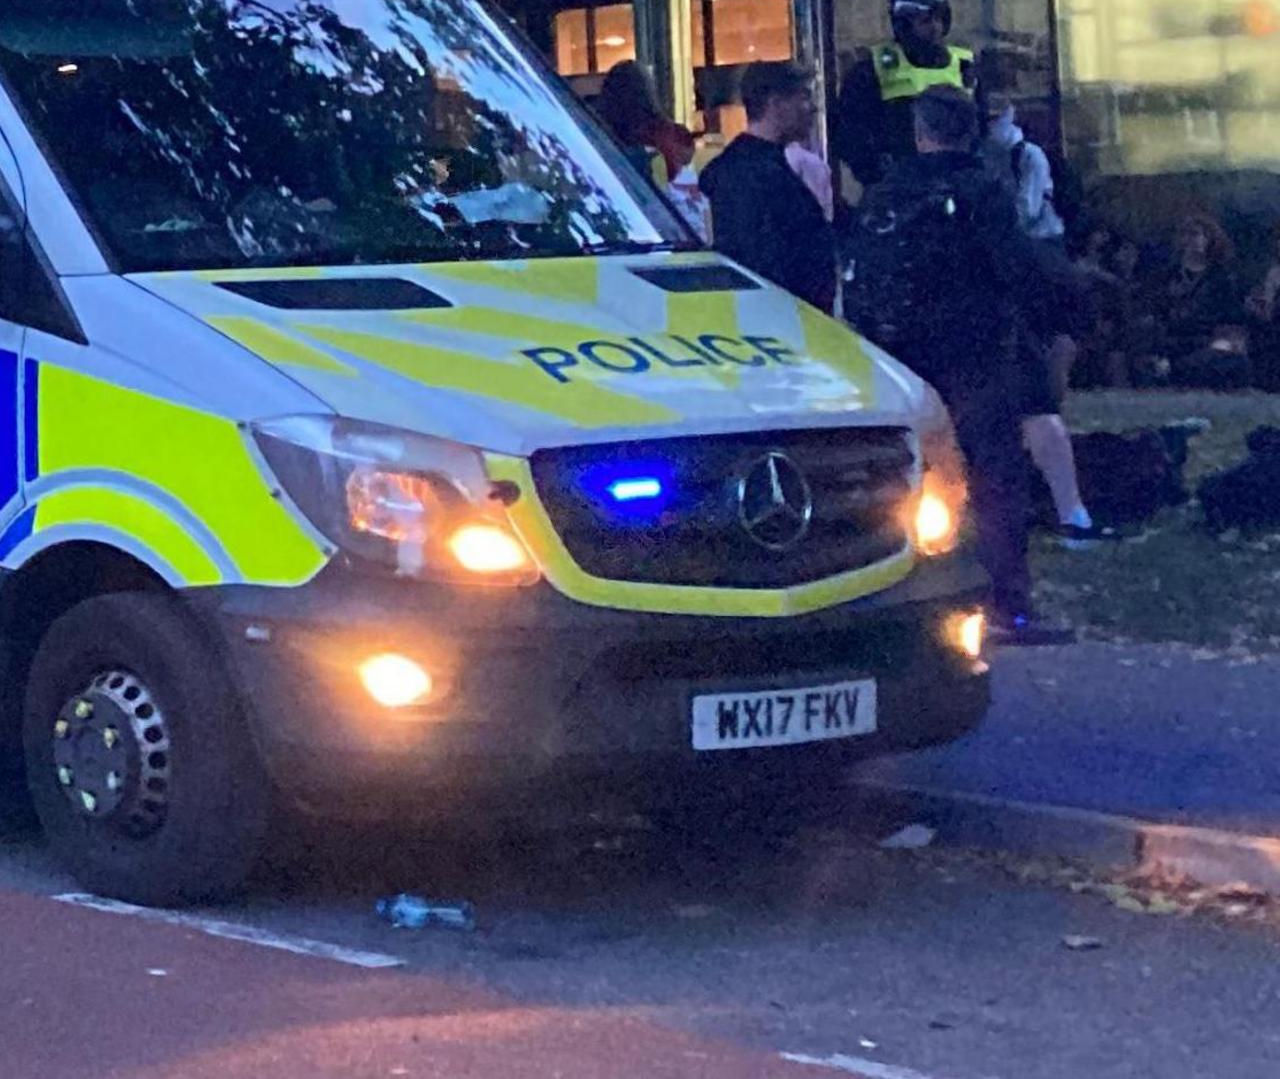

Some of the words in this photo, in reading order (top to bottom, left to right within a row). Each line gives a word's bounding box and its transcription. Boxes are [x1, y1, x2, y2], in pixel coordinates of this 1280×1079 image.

[520, 333, 797, 383] POLICE
[718, 697, 794, 740] WX17
[805, 688, 859, 732] FKV
